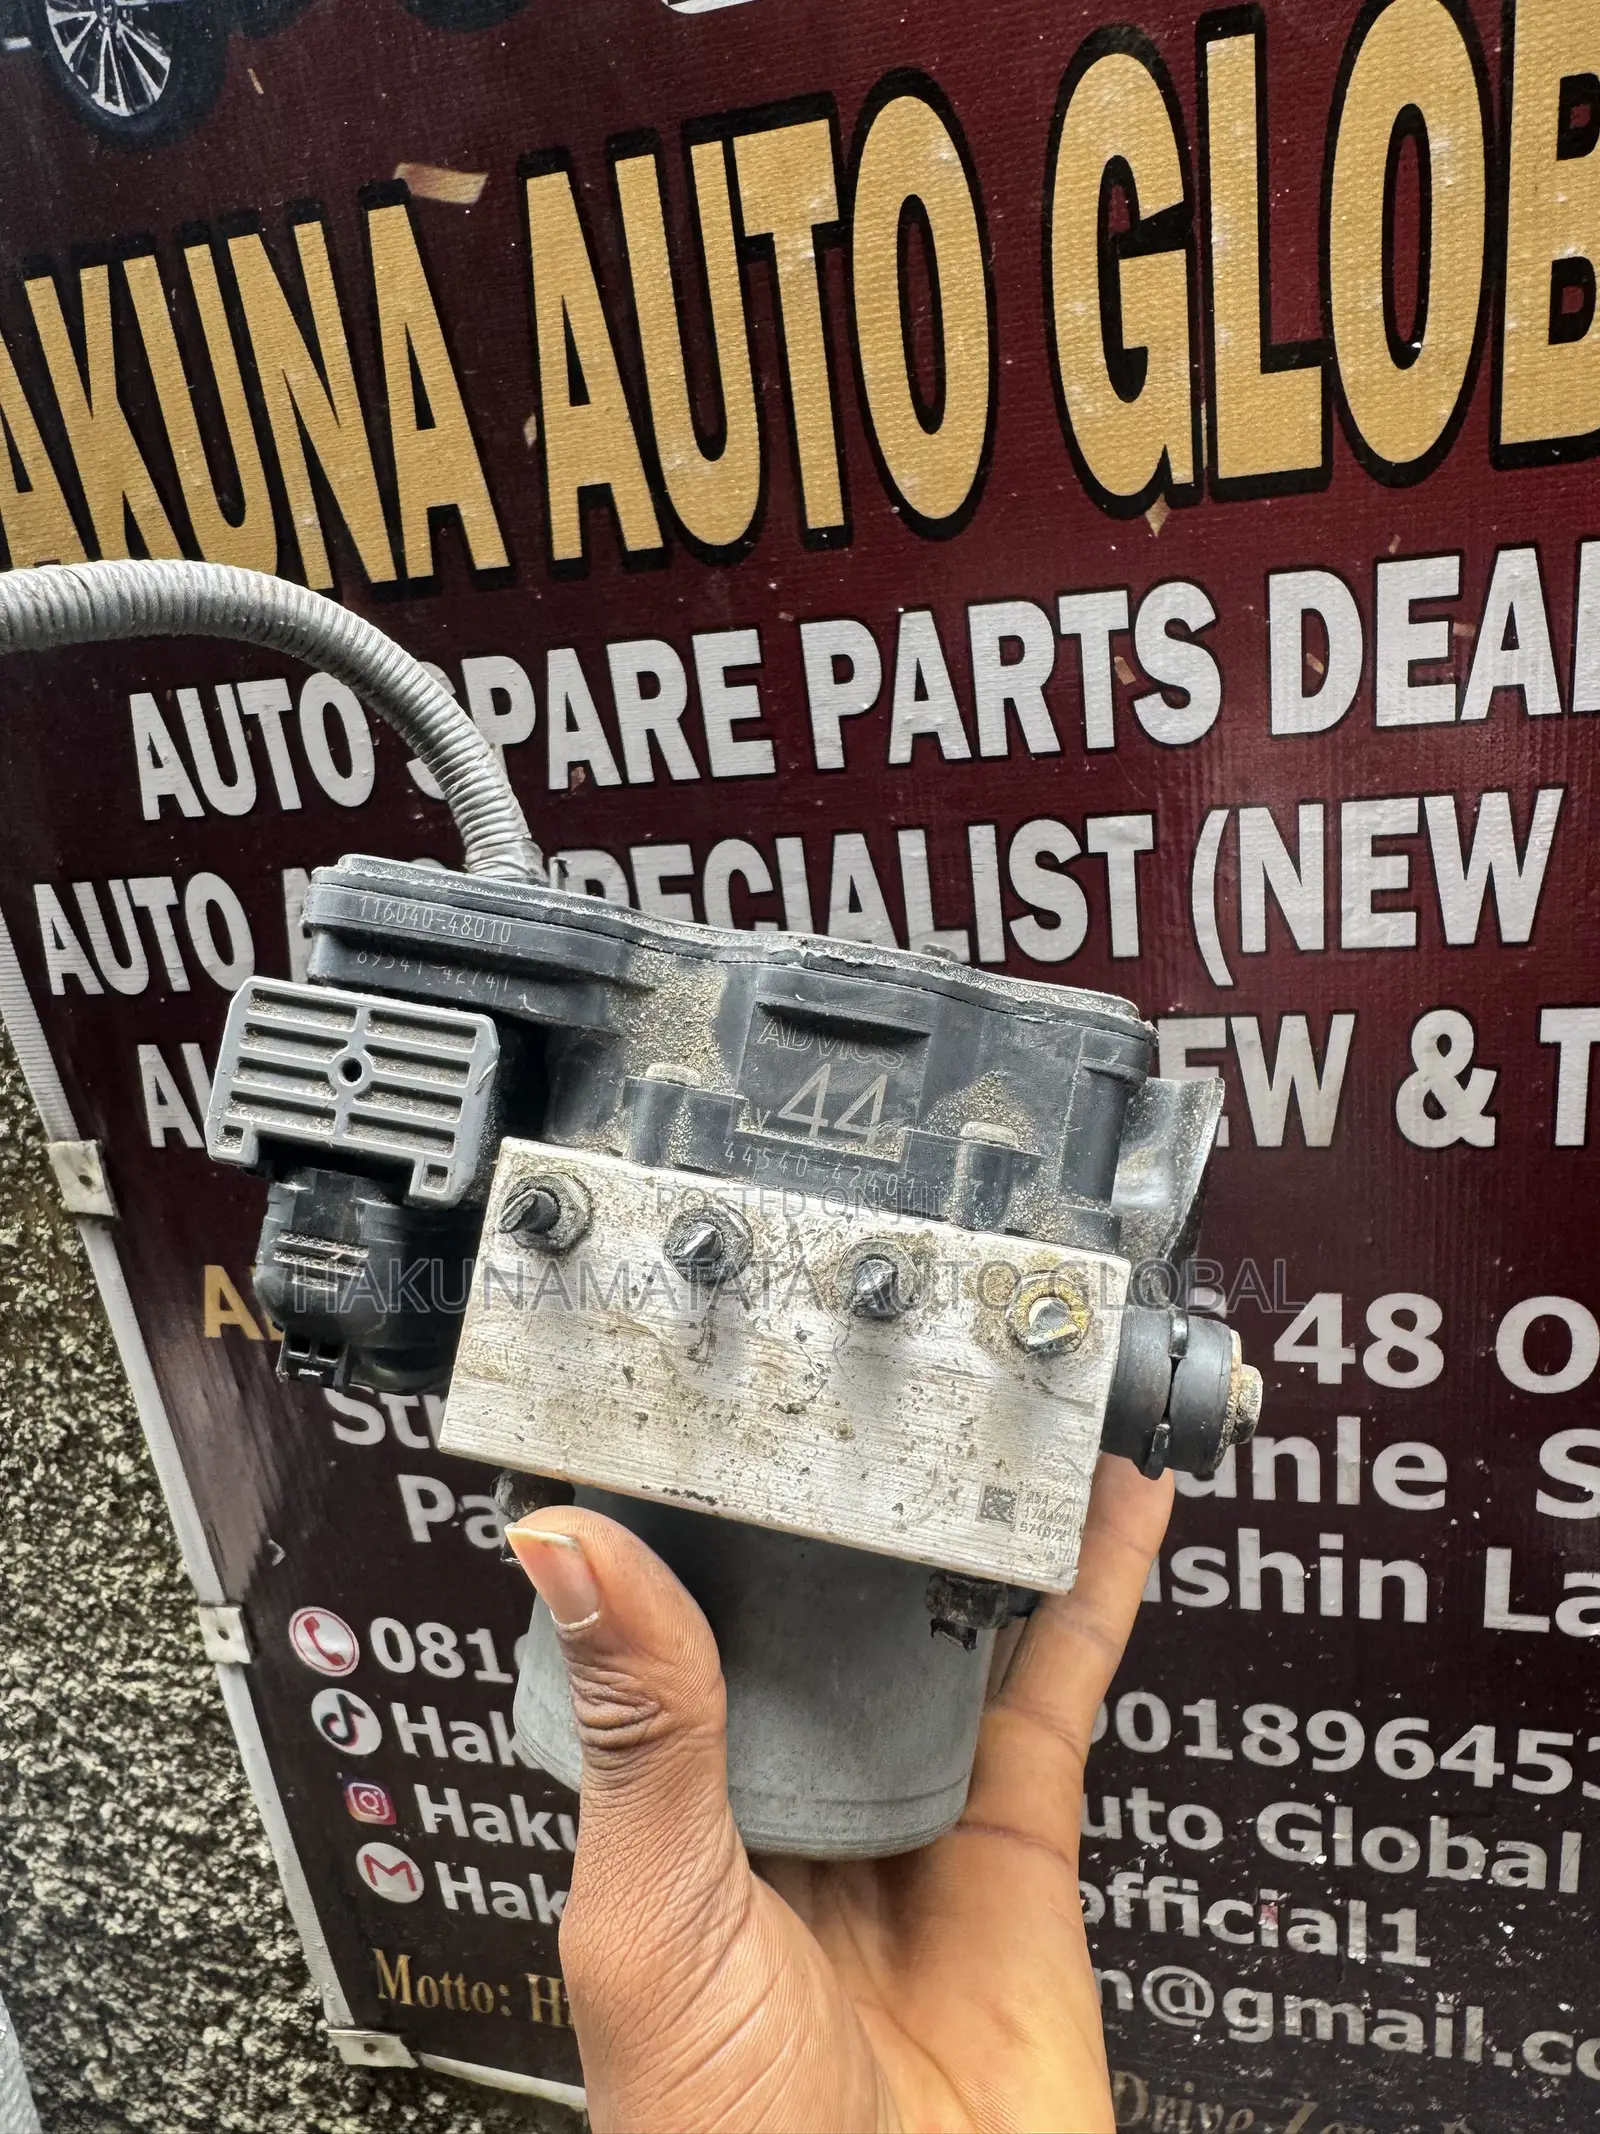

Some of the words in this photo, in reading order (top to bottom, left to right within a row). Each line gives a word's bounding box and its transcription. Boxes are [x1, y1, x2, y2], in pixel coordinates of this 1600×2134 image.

[525, 94, 990, 562] AUTO
[1050, 0, 1600, 498] GLOB
[129, 672, 375, 821] AUTO
[800, 579, 1222, 770] PARTS
[33, 872, 256, 996] AUTO
[1191, 788, 1564, 986] (NEW
[777, 1062, 890, 1147] 44
[1396, 1008, 1498, 1149] &
[1273, 1293, 1445, 1389] 48
[1141, 1528, 1428, 1624] shin
[369, 1616, 524, 1685] 081
[1256, 1800, 1583, 1895] Global
[372, 1948, 513, 2016] Motto:
